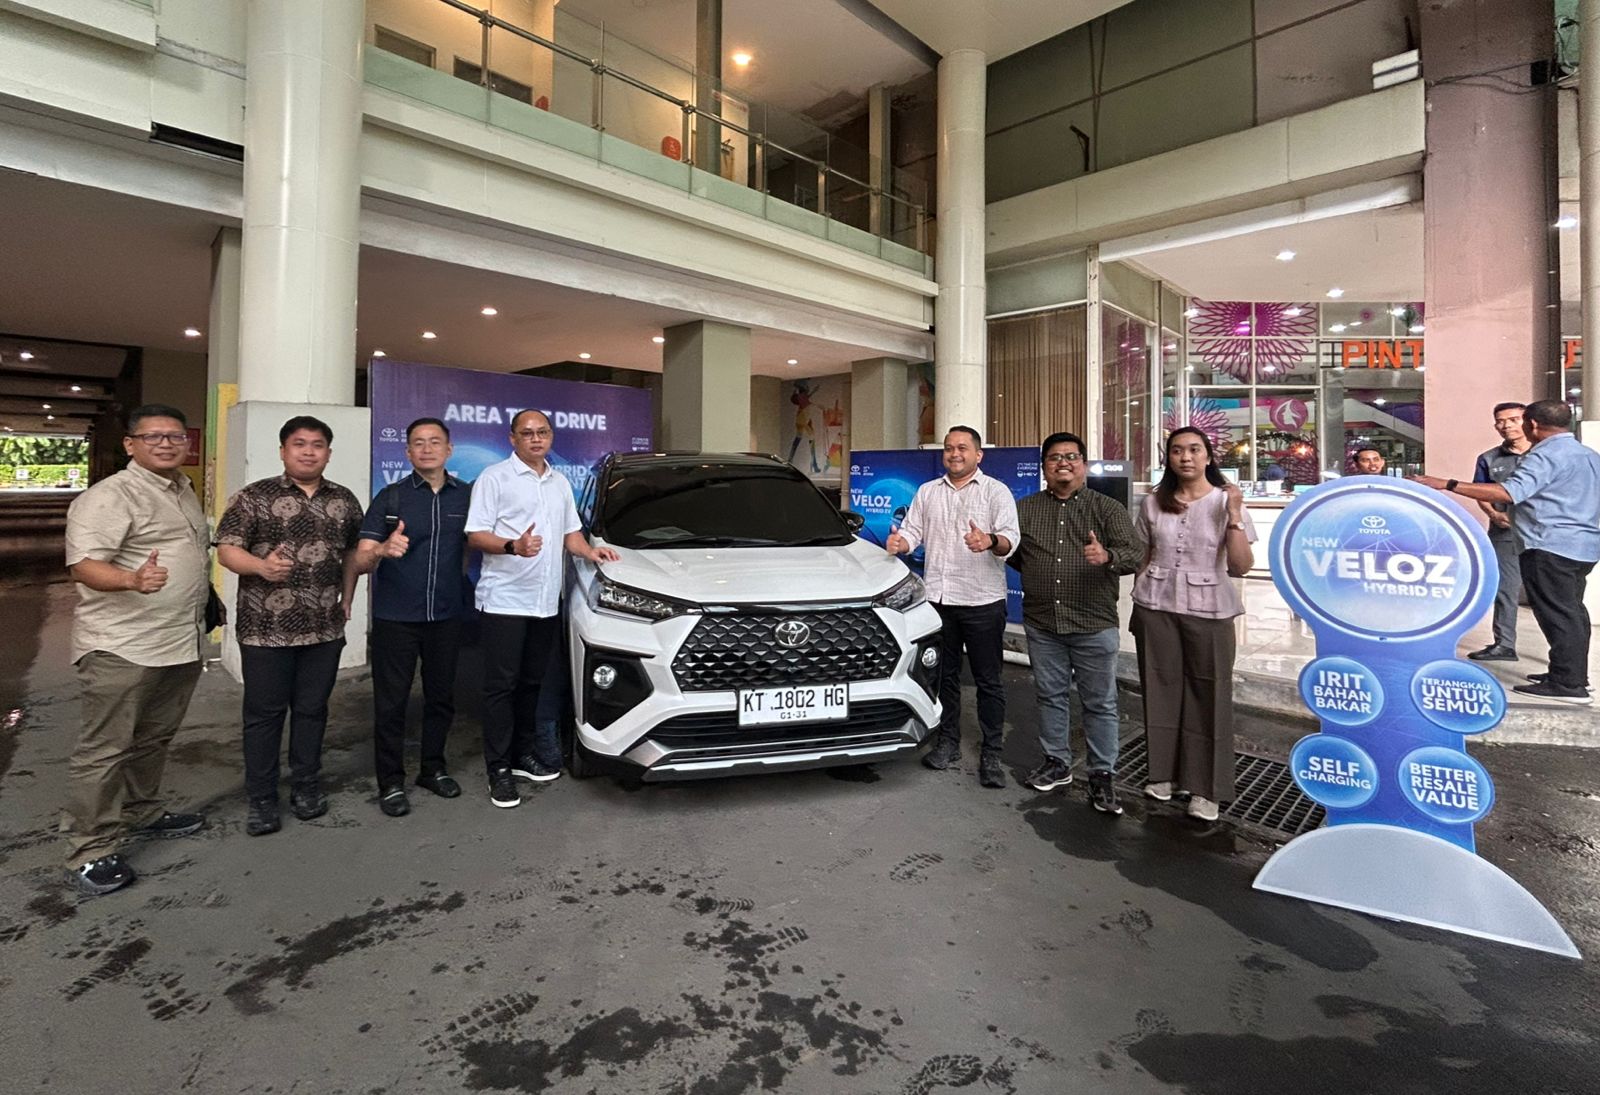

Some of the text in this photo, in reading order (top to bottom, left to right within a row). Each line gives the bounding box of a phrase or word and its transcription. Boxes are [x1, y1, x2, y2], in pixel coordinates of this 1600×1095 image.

[1342, 339, 1424, 369] PINT
[444, 403, 503, 424] AREA
[555, 411, 607, 430] DRIVE
[381, 461, 403, 469] NEW
[852, 494, 892, 508] VELOZ
[1301, 536, 1339, 549] NEW
[1303, 550, 1456, 585] VELOZ
[1363, 582, 1454, 600] HYBRID EV
[1319, 670, 1364, 690] IRIT
[1421, 677, 1491, 691] TERJANGKAU
[744, 687, 844, 712] KT 1802 HG
[1313, 685, 1372, 702] BAHAN
[1421, 685, 1494, 704] UNTUK
[1315, 697, 1372, 714] BAKAR
[1422, 697, 1495, 717] SEMUA
[1308, 756, 1360, 777] SELF
[1409, 762, 1477, 783] BETTER
[1299, 769, 1372, 790] CHARGING
[1411, 775, 1479, 796] RESALE
[1412, 787, 1480, 811] VALUE
